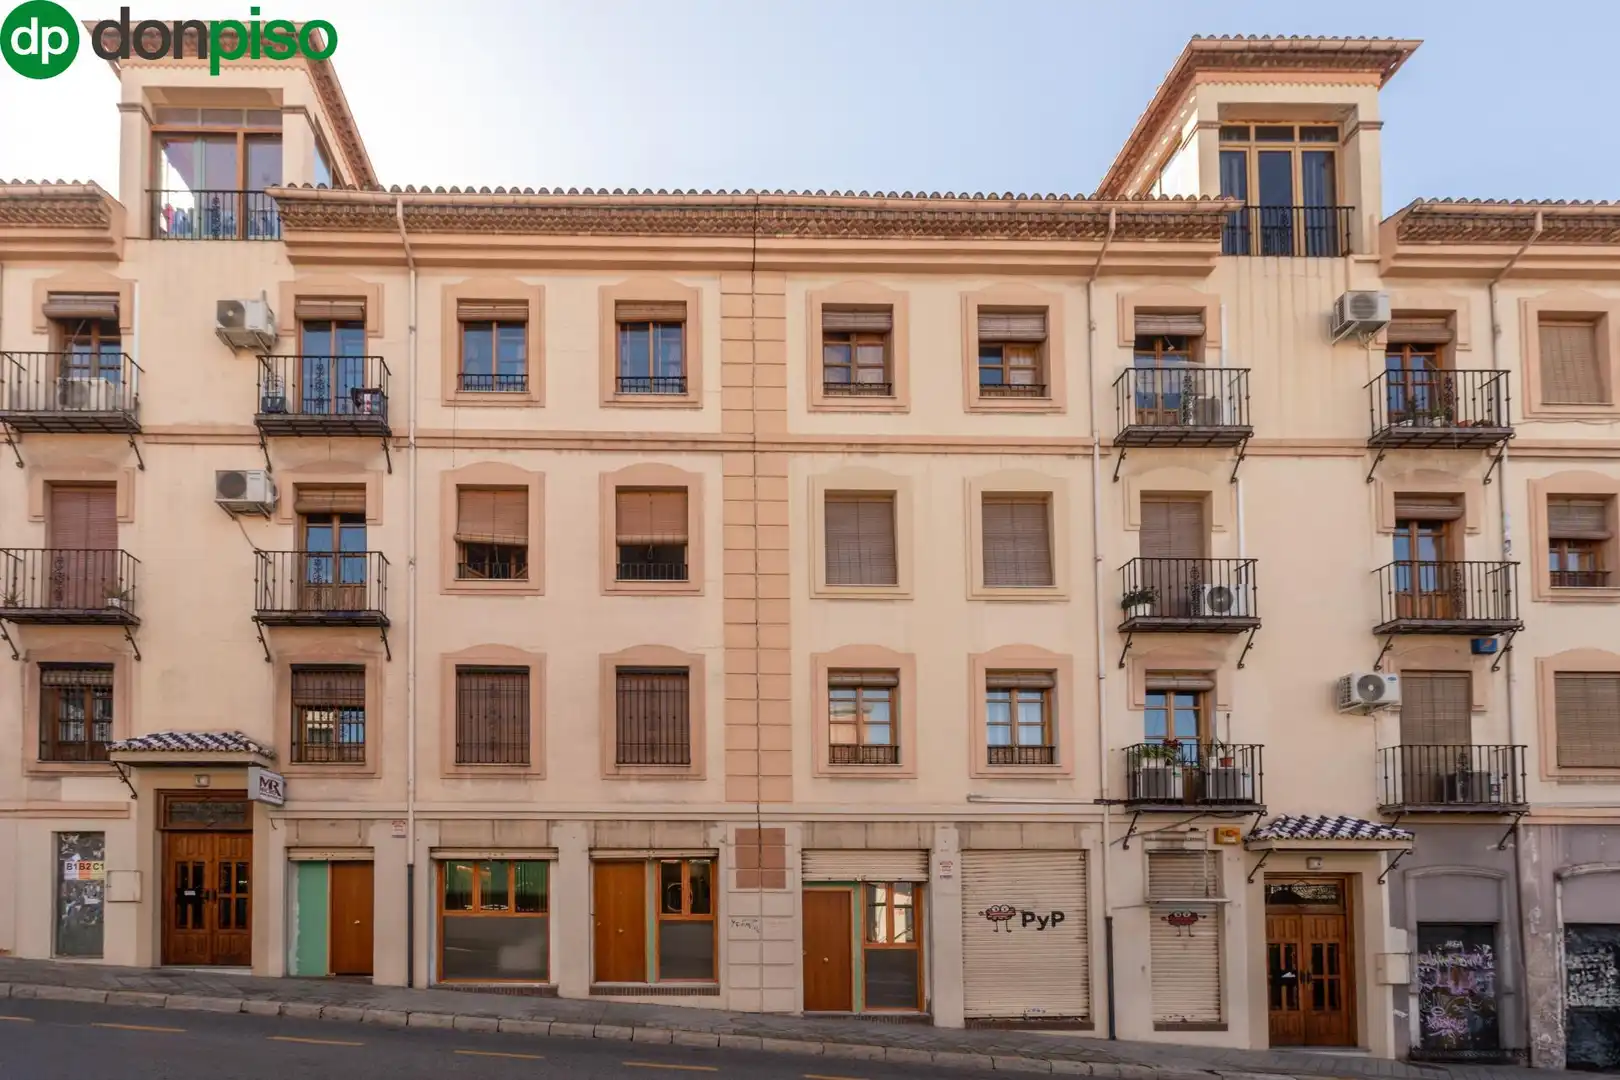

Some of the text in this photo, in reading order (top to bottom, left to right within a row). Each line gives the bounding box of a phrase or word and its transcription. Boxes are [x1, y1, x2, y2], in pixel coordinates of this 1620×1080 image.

[259, 776, 281, 797] MR
[66, 862, 104, 871] B1 B2 C1
[1021, 911, 1065, 931] PyP
